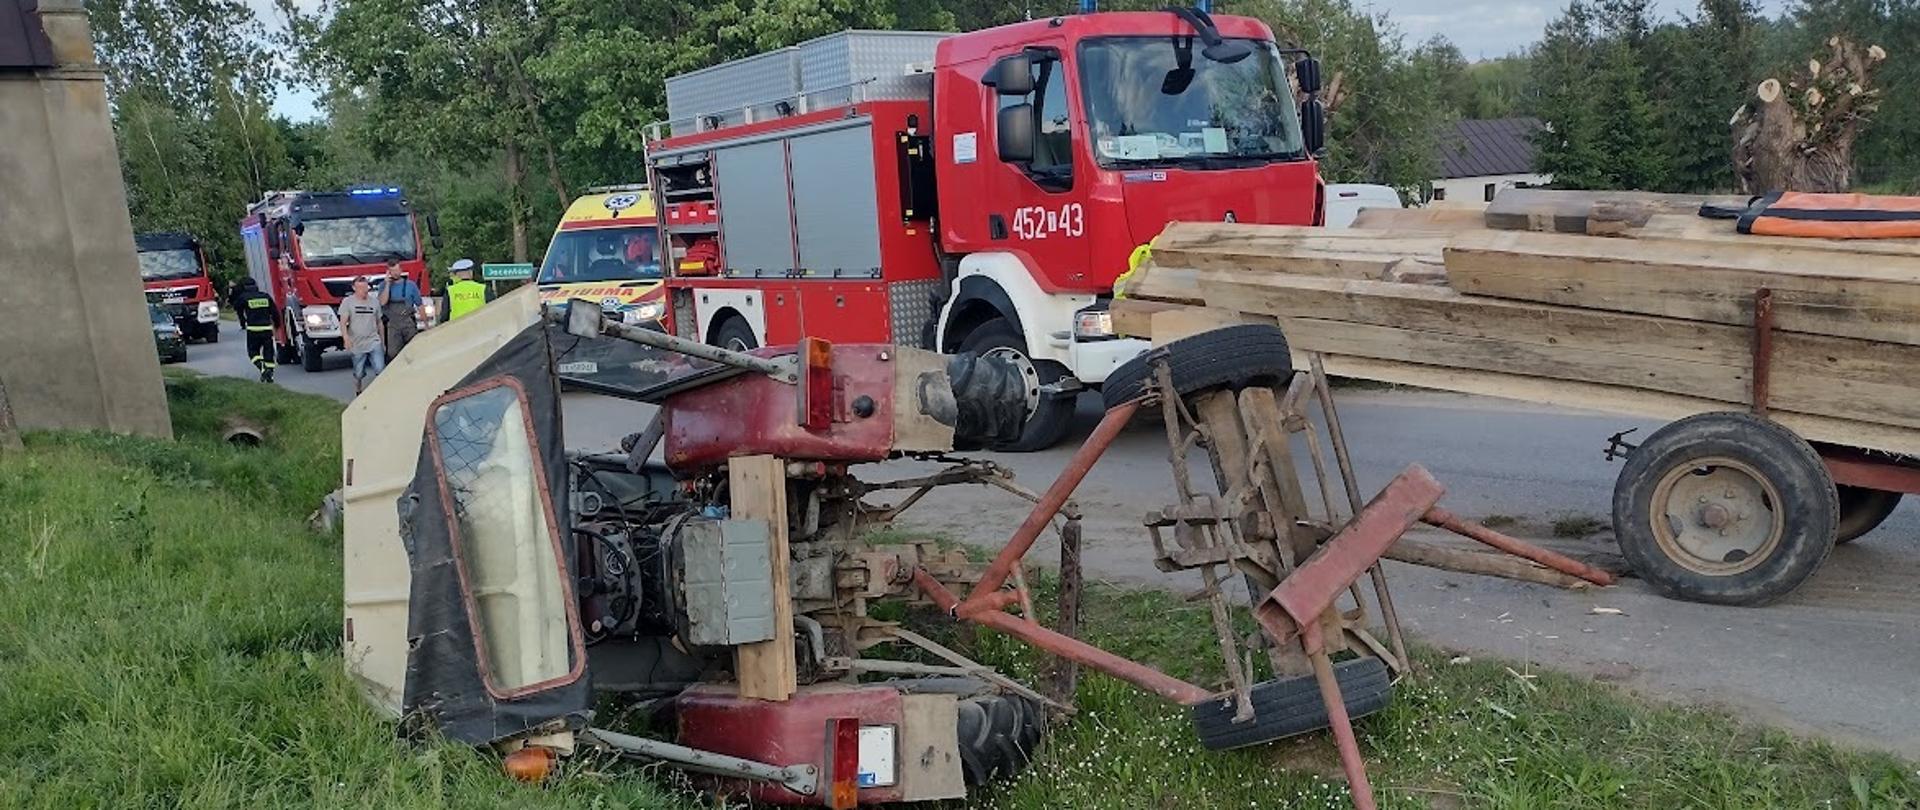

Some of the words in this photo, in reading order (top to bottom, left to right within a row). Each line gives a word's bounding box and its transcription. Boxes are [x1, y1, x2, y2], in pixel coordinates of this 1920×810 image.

[1012, 206, 1047, 240] 452
[1059, 203, 1084, 237] 43
[454, 292, 480, 300] POLICJA
